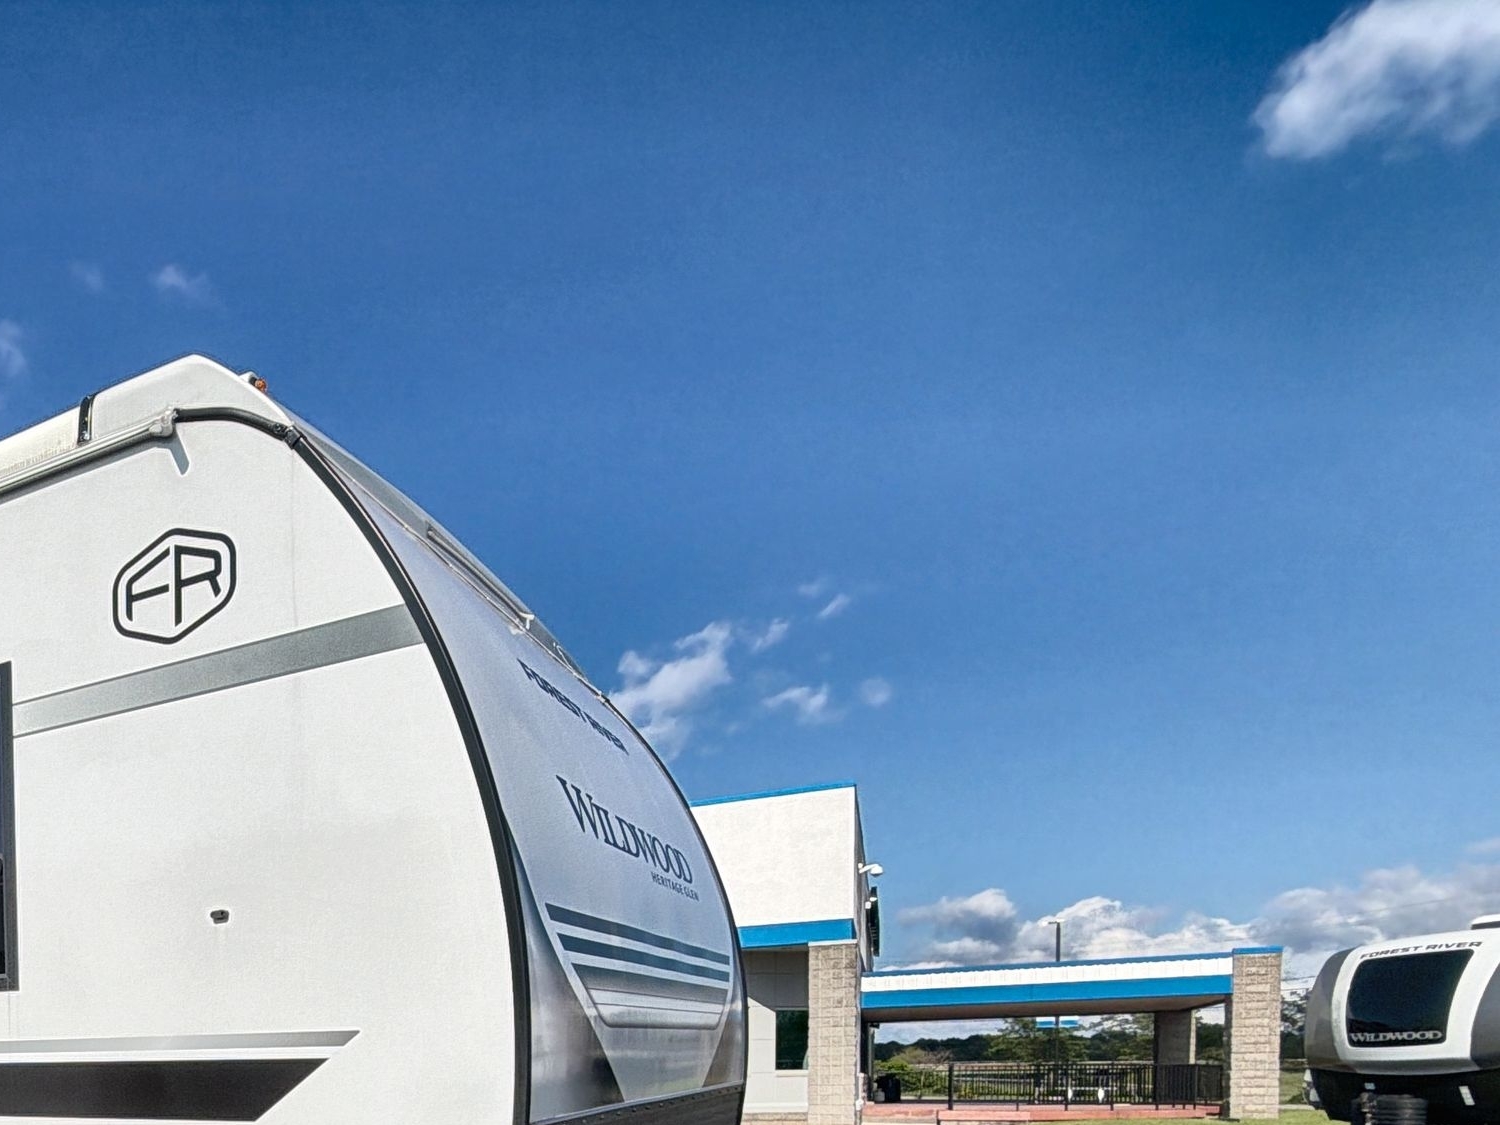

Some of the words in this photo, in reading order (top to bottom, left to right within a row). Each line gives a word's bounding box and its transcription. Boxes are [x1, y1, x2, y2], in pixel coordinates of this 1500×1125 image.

[650, 871, 684, 896] HERITAGE
[1360, 946, 1423, 959] FOREST
[1425, 942, 1482, 951] RIVER
